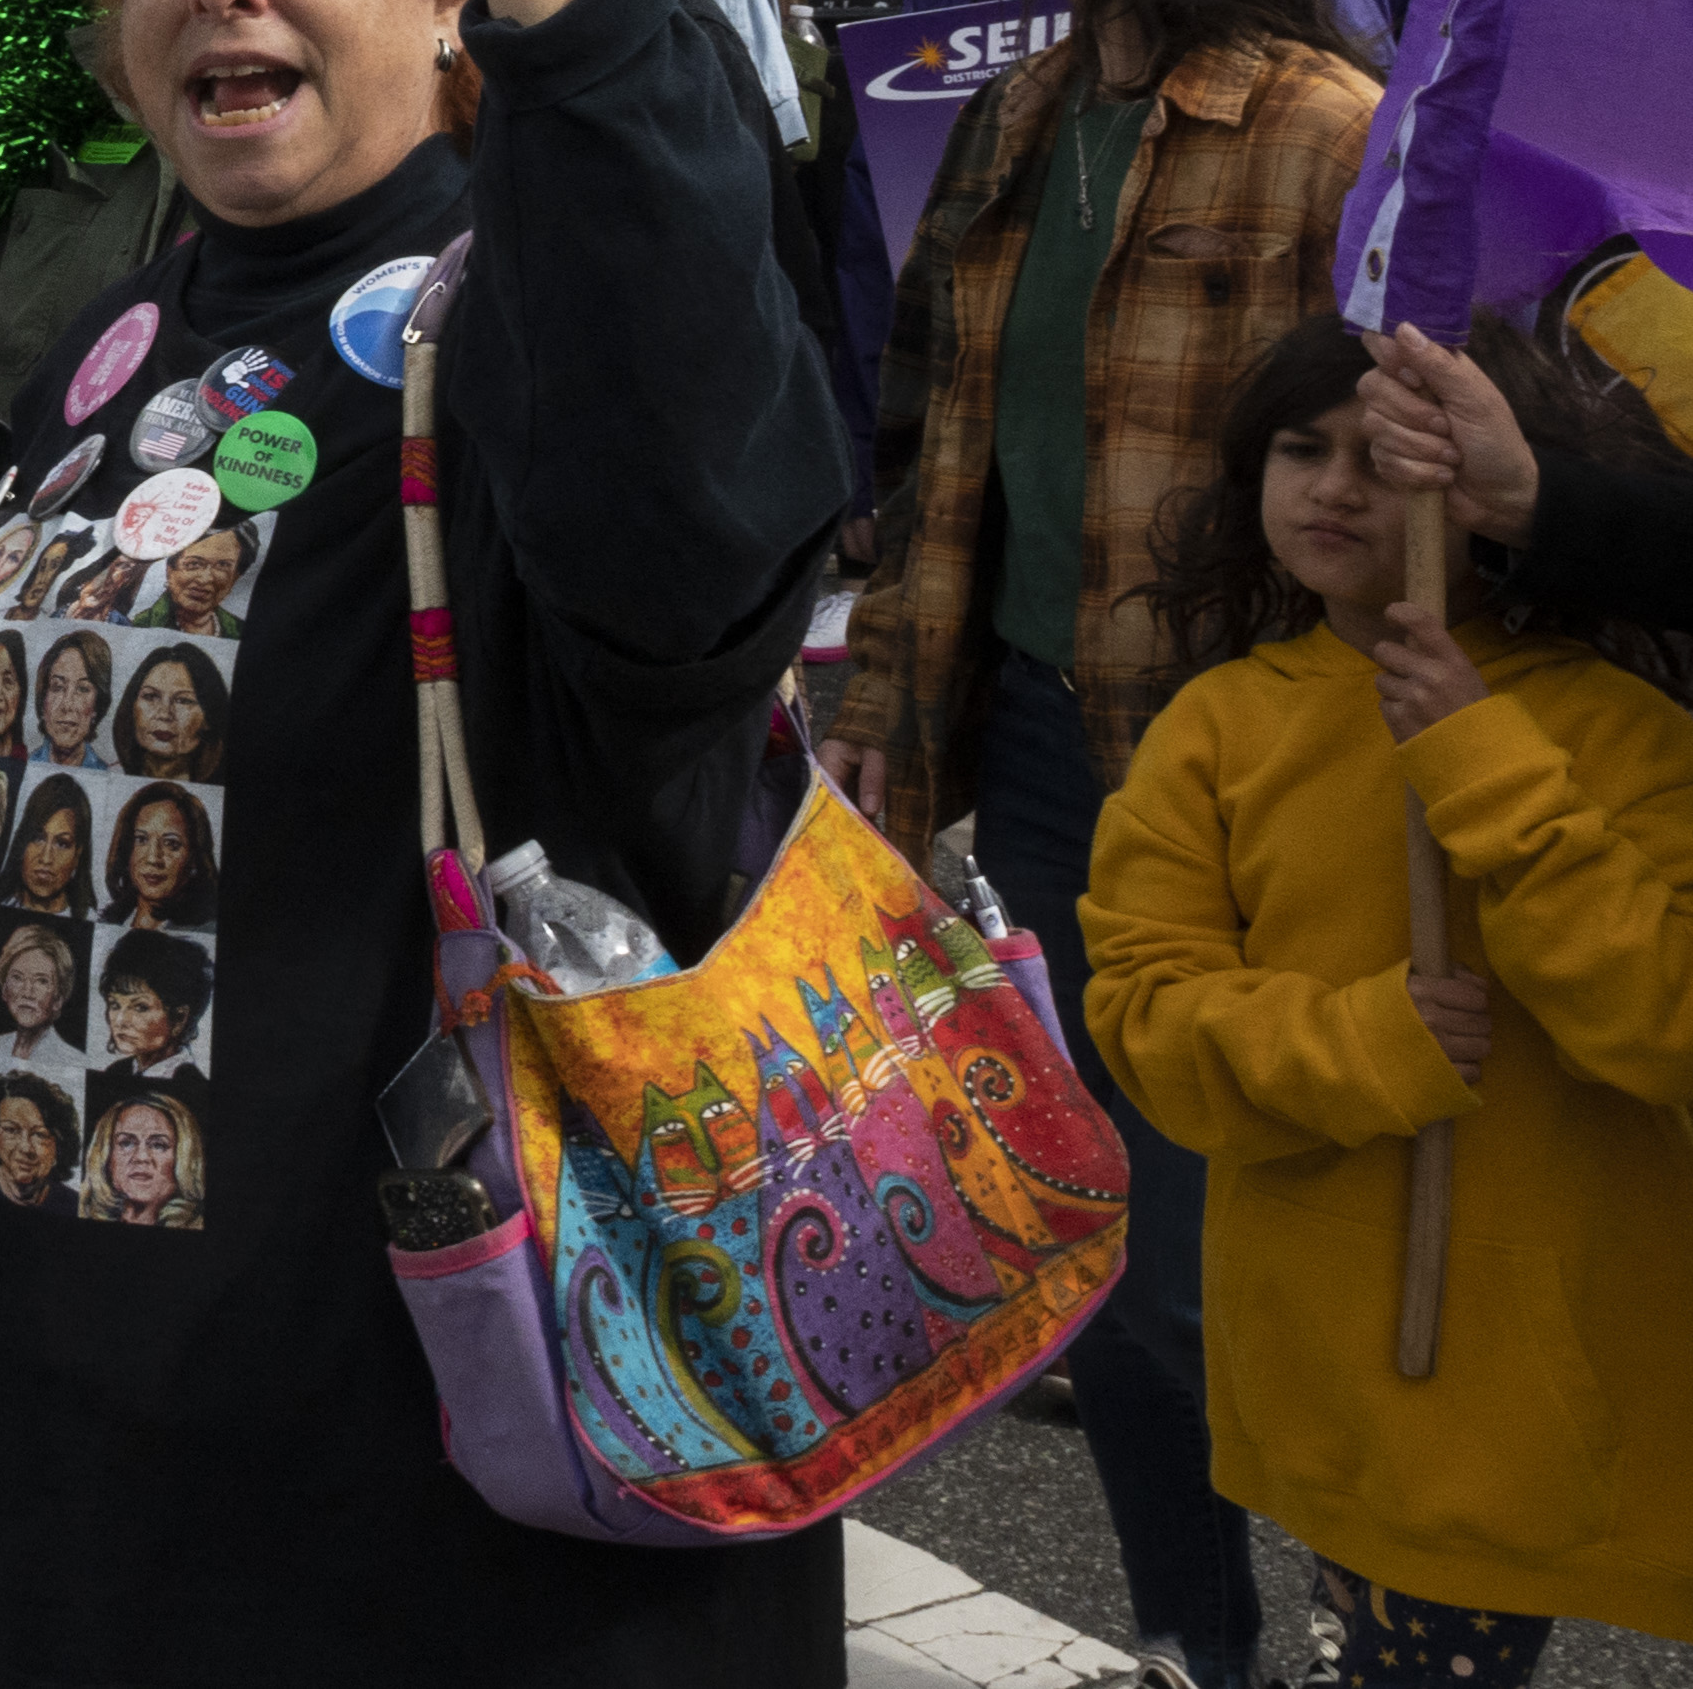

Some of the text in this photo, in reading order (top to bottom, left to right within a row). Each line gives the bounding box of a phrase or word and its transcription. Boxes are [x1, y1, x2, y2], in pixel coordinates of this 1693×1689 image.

[352, 262, 421, 295] WOMEN'S
[260, 367, 289, 389] IS
[225, 385, 264, 414] GUN
[238, 427, 302, 454] POWER
[254, 450, 274, 462] OF
[215, 456, 304, 489] KINDNESS
[186, 481, 211, 493] Keep
[181, 491, 203, 502] Your
[173, 501, 198, 512] Laws
[162, 514, 195, 526] Out Of
[165, 525, 179, 535] My
[154, 534, 179, 547] Body
